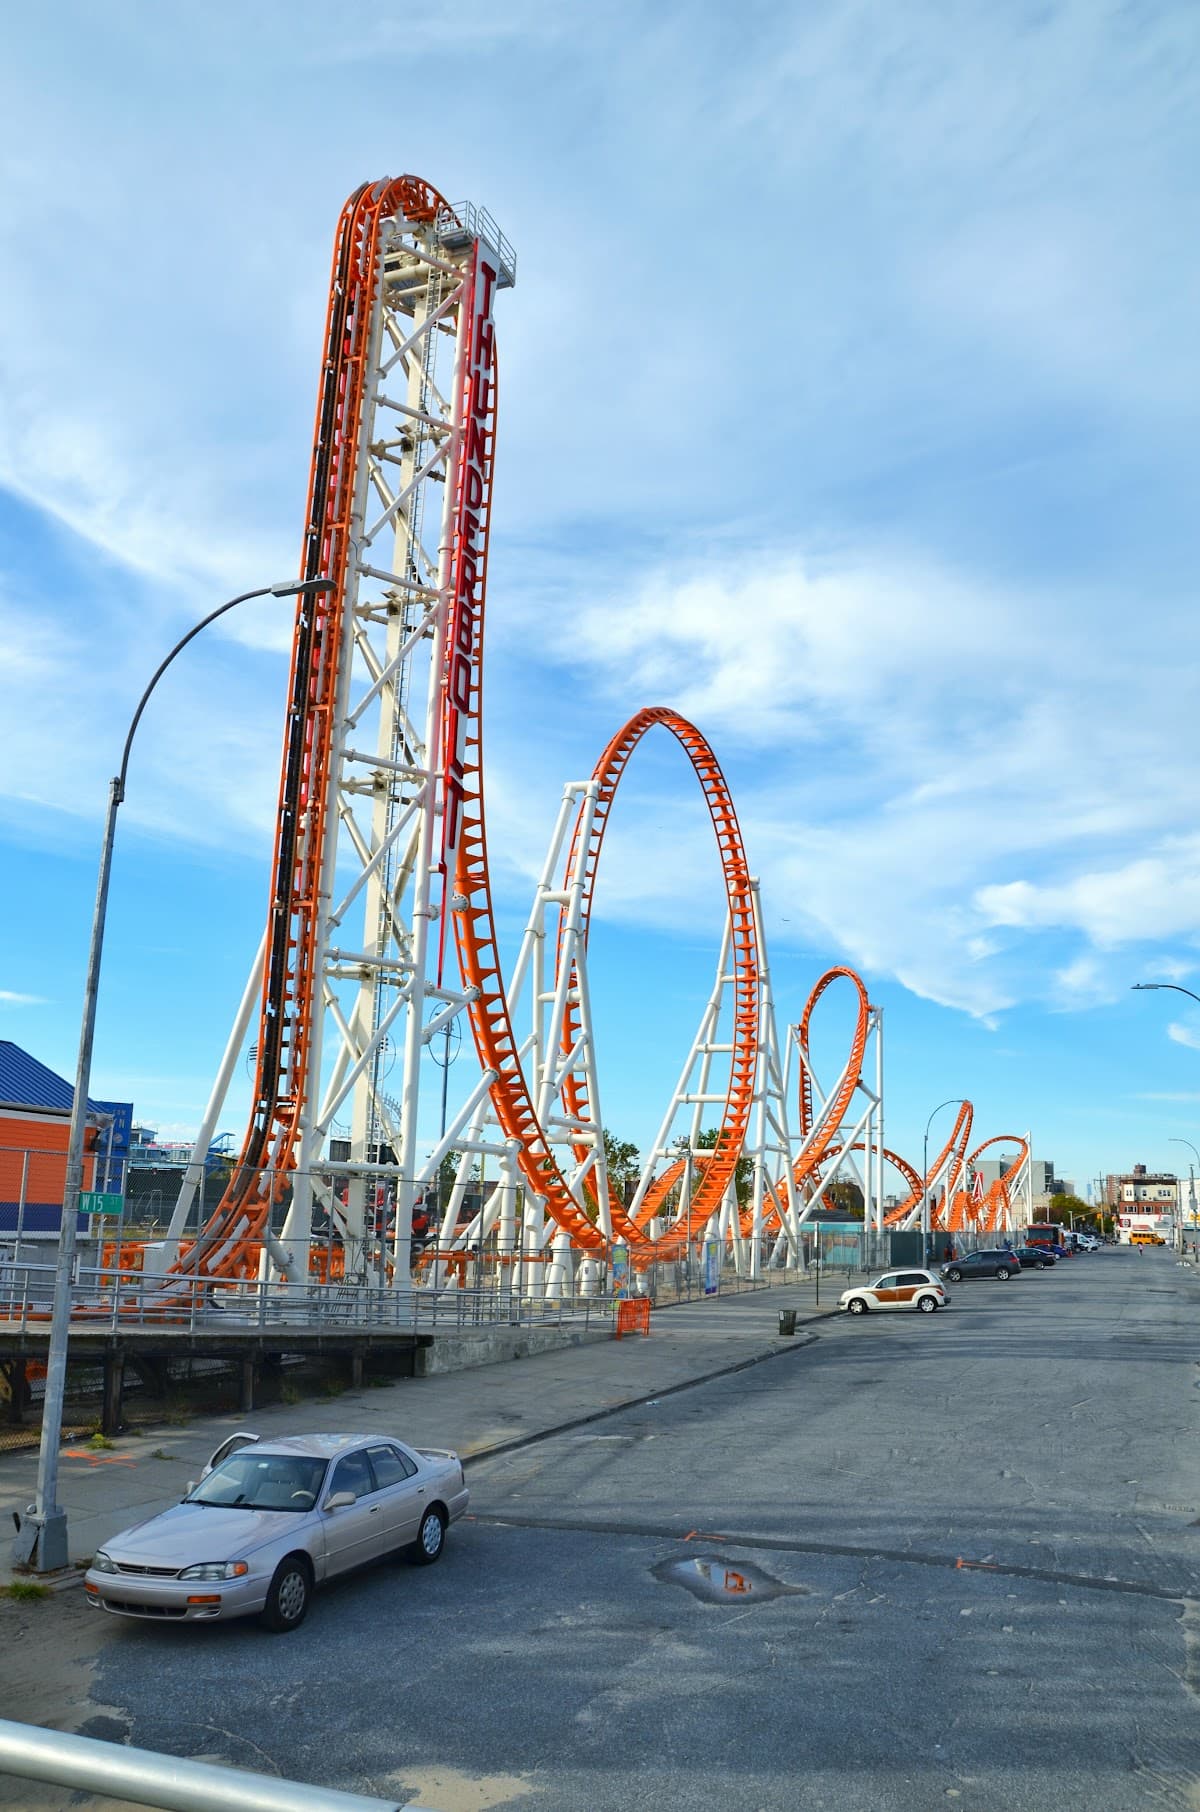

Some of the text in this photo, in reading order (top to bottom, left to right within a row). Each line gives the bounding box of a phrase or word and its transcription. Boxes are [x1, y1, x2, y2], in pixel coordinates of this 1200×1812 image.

[446, 261, 496, 849] THUNDERBOLT
[82, 1194, 91, 1210] W
[92, 1195, 104, 1212] 15
